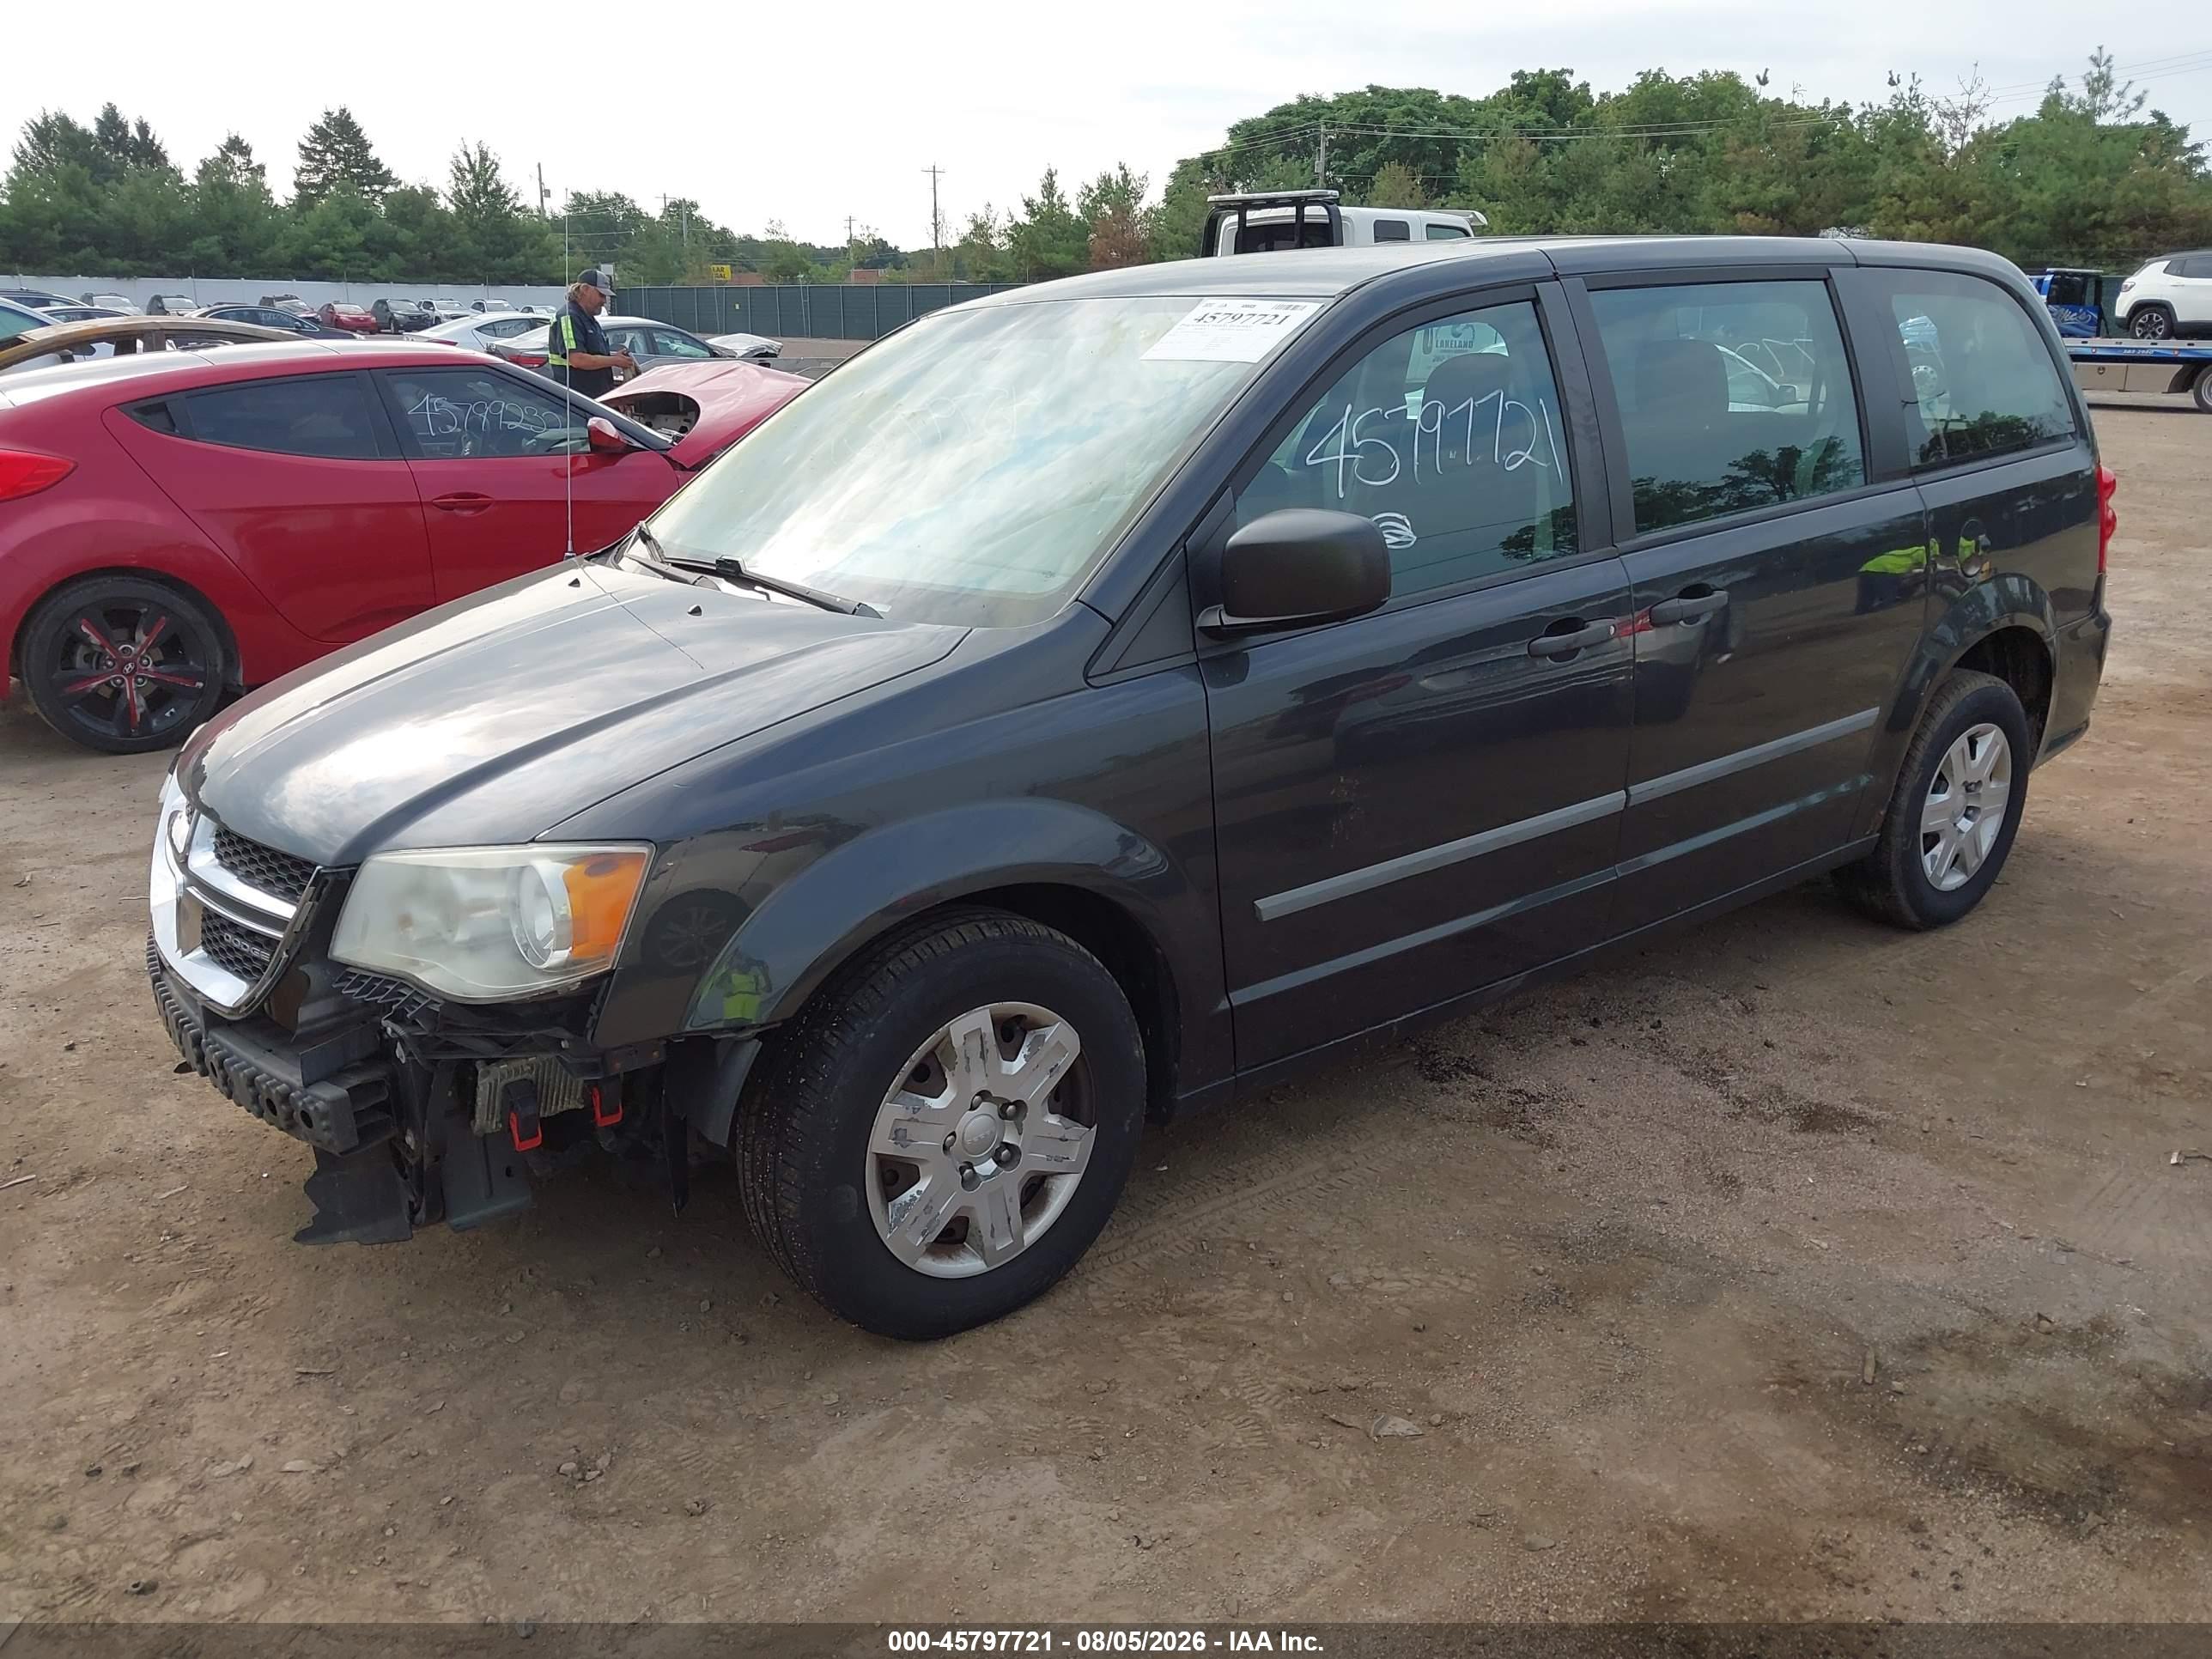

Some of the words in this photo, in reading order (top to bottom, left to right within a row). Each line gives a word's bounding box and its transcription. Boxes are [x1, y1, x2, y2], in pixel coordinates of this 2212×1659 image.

[1194, 312, 1291, 325] 45797721
[1435, 338, 1474, 349] LAKELAND
[1305, 388, 1564, 499] 45797721
[223, 933, 271, 963] DODGE
